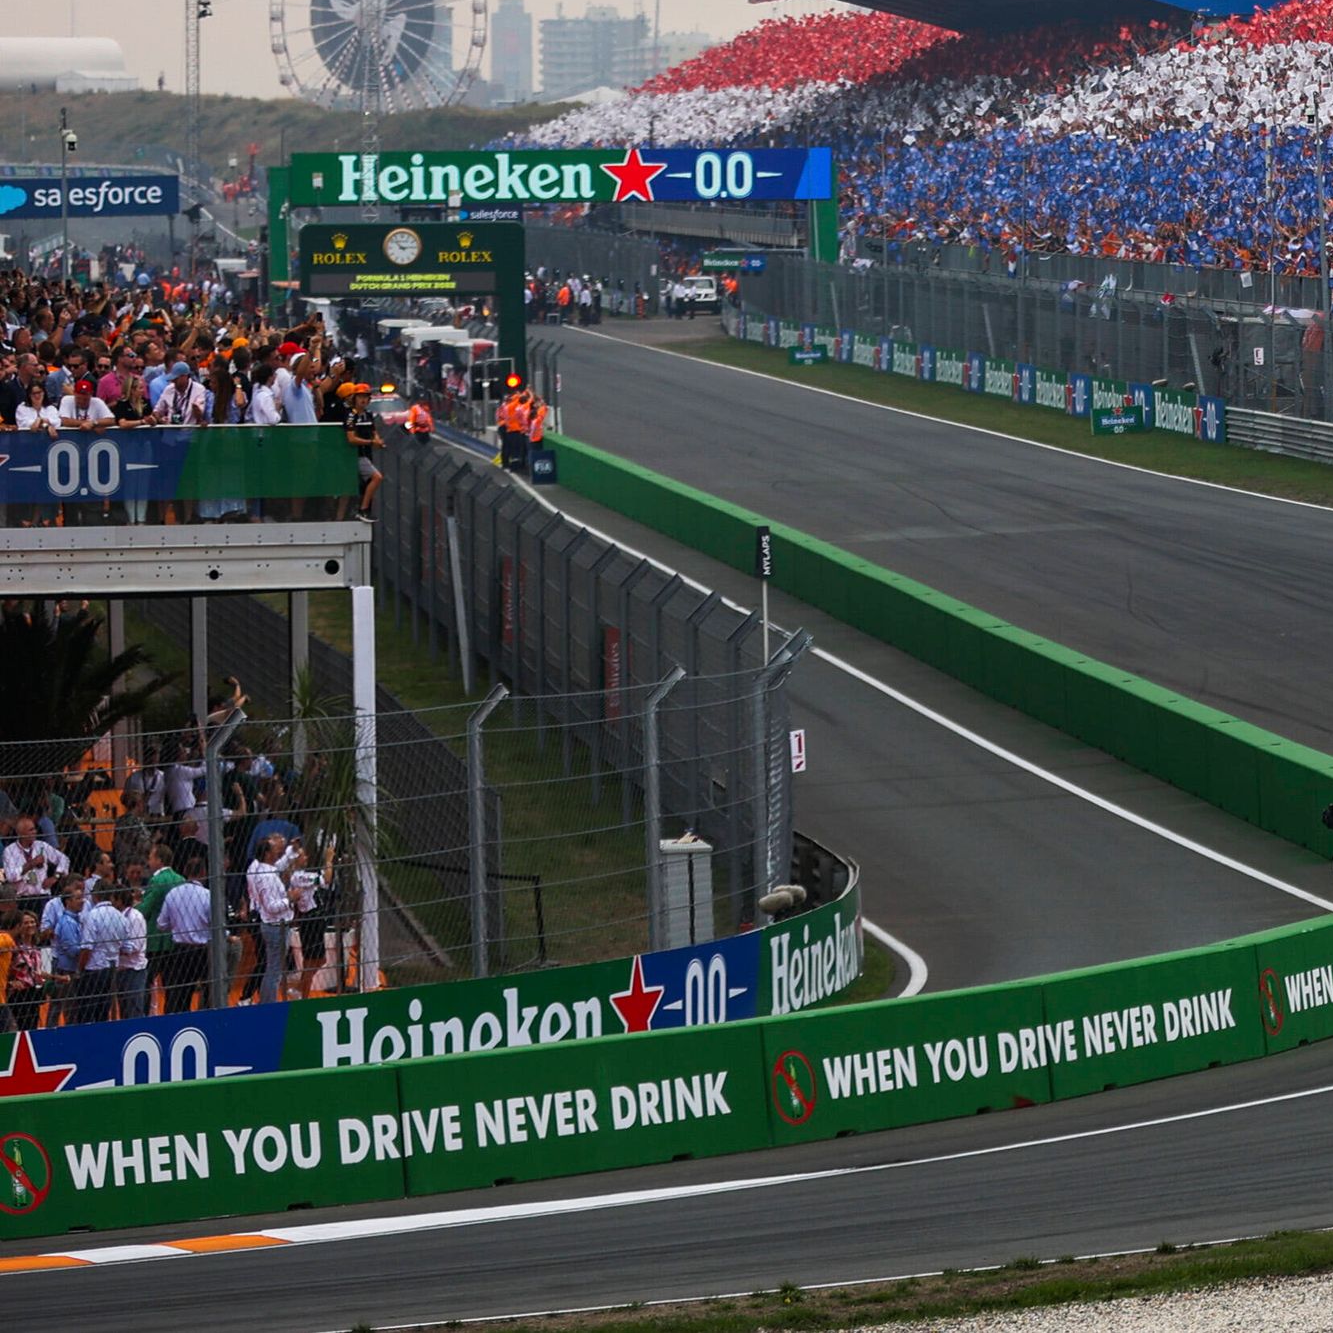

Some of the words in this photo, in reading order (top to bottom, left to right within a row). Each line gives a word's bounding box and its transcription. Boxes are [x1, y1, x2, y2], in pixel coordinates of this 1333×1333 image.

[34, 181, 162, 212] saesforce
[338, 153, 595, 201] Heineken
[695, 151, 754, 199] 0.0
[470, 209, 518, 221] salesforce
[312, 253, 367, 265] ROLEX
[438, 251, 492, 263] ROLEX
[1154, 391, 1193, 435] Heineken
[47, 439, 121, 498] 0.0
[761, 535, 771, 575] MYLAPS
[685, 954, 727, 1026] 00
[770, 912, 858, 1016] Heineken
[822, 1046, 918, 1100] WHEN
[924, 1036, 988, 1084] YOU
[998, 1020, 1077, 1074] DRIVE
[1083, 1004, 1158, 1057] NEVER
[1163, 988, 1236, 1043] DRINK
[65, 1132, 210, 1190] WHEN
[222, 1121, 321, 1174] YOU
[338, 1105, 463, 1165] DRIVE
[474, 1089, 599, 1148] NEVER
[611, 1071, 731, 1131] DRINK
